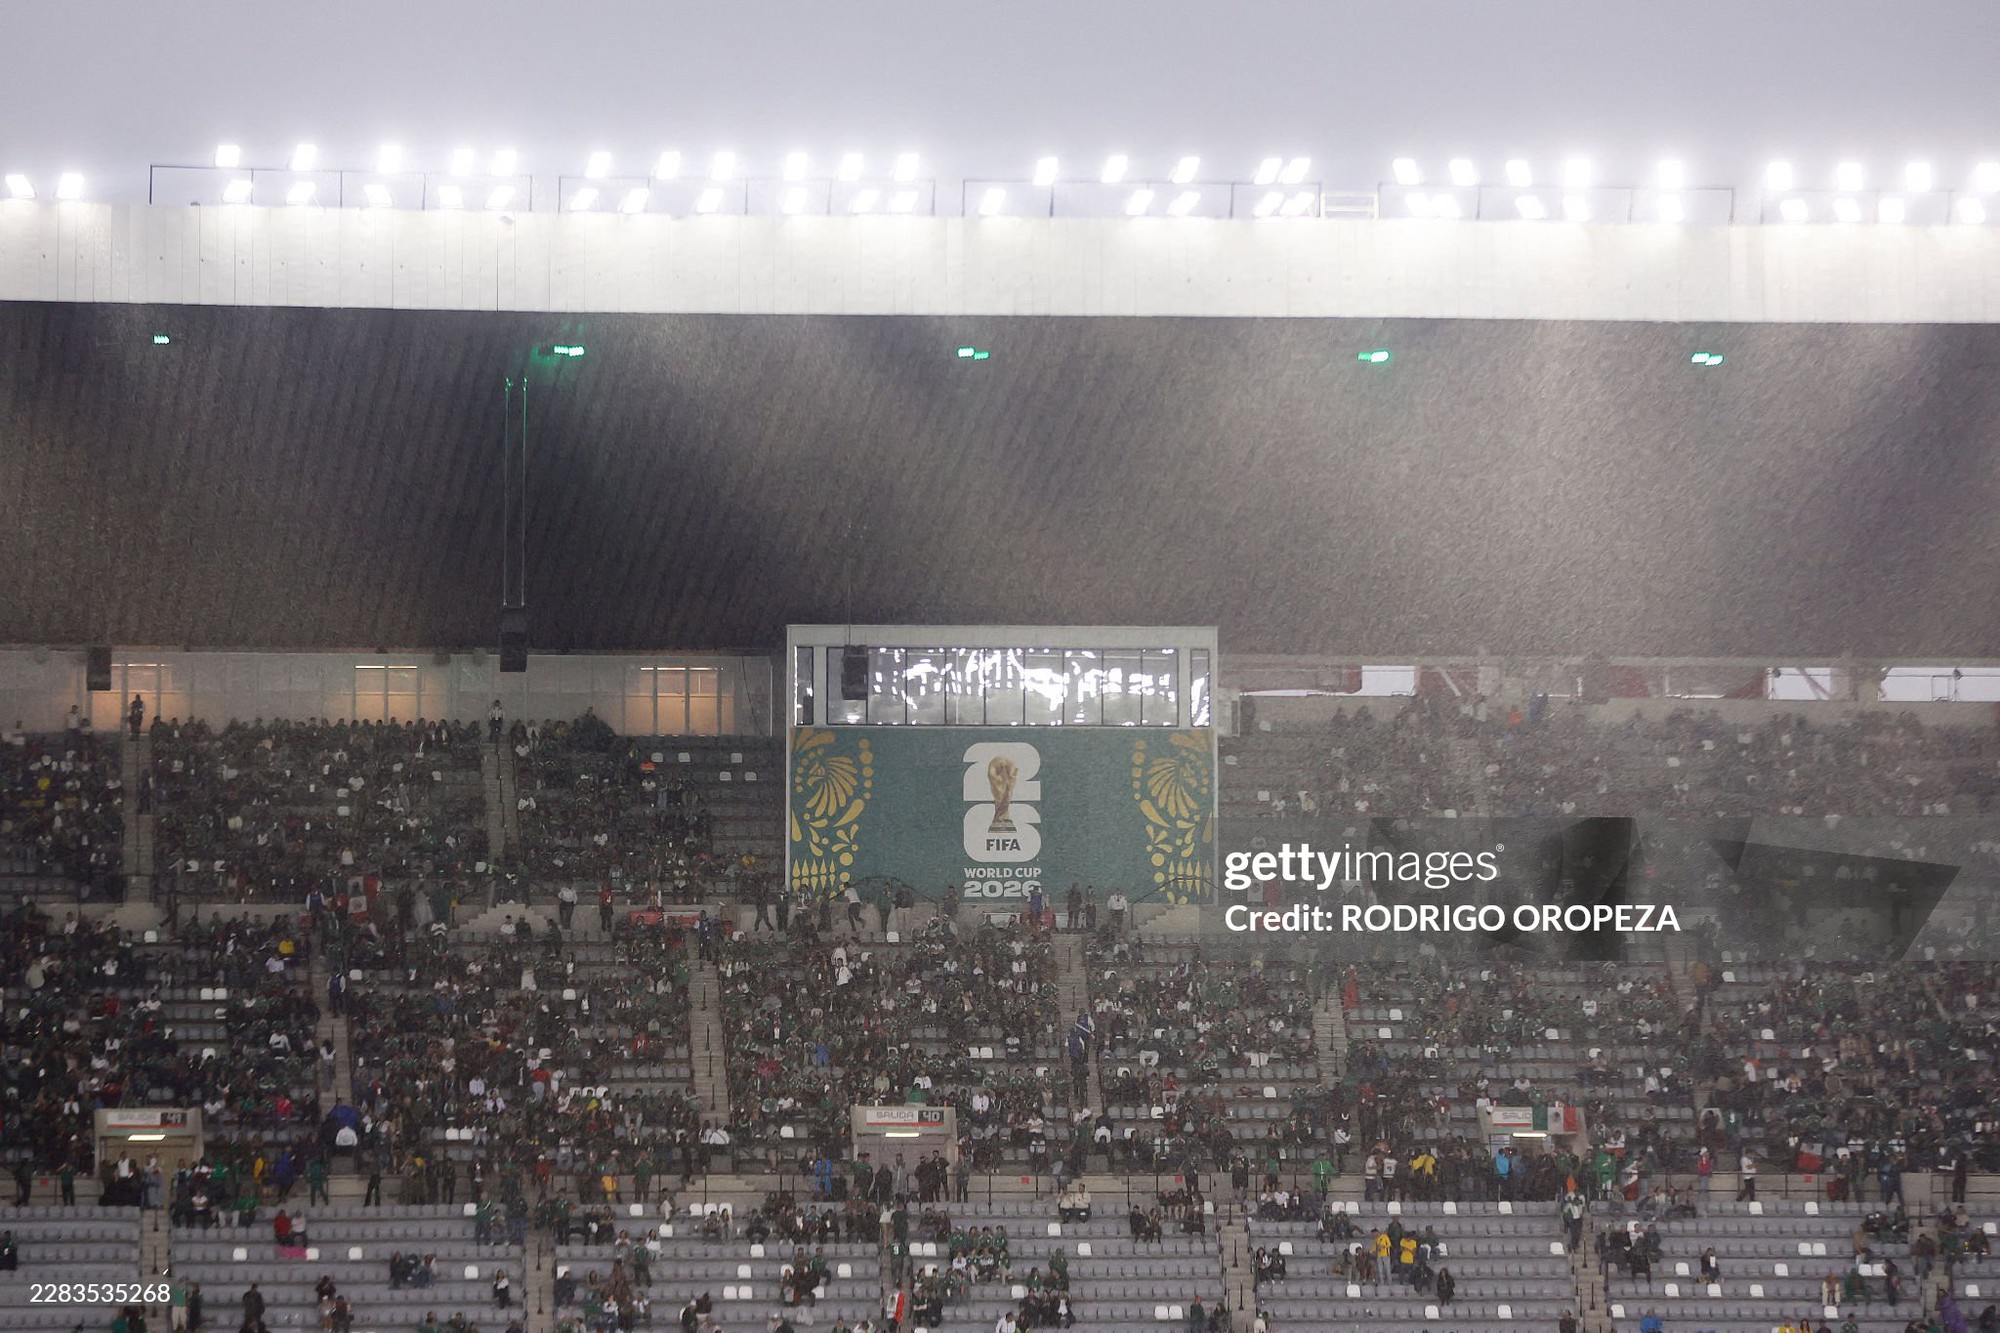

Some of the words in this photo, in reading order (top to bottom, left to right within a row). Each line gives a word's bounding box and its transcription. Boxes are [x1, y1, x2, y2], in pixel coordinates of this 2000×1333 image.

[986, 838, 1021, 851] FIFA
[964, 867, 1013, 878] WORLD
[1015, 867, 1042, 878] CUP
[964, 880, 1042, 898] 2026
[876, 1111, 914, 1119] SALIDA
[922, 1111, 940, 1121] 40
[1502, 1111, 1531, 1120] SALID
